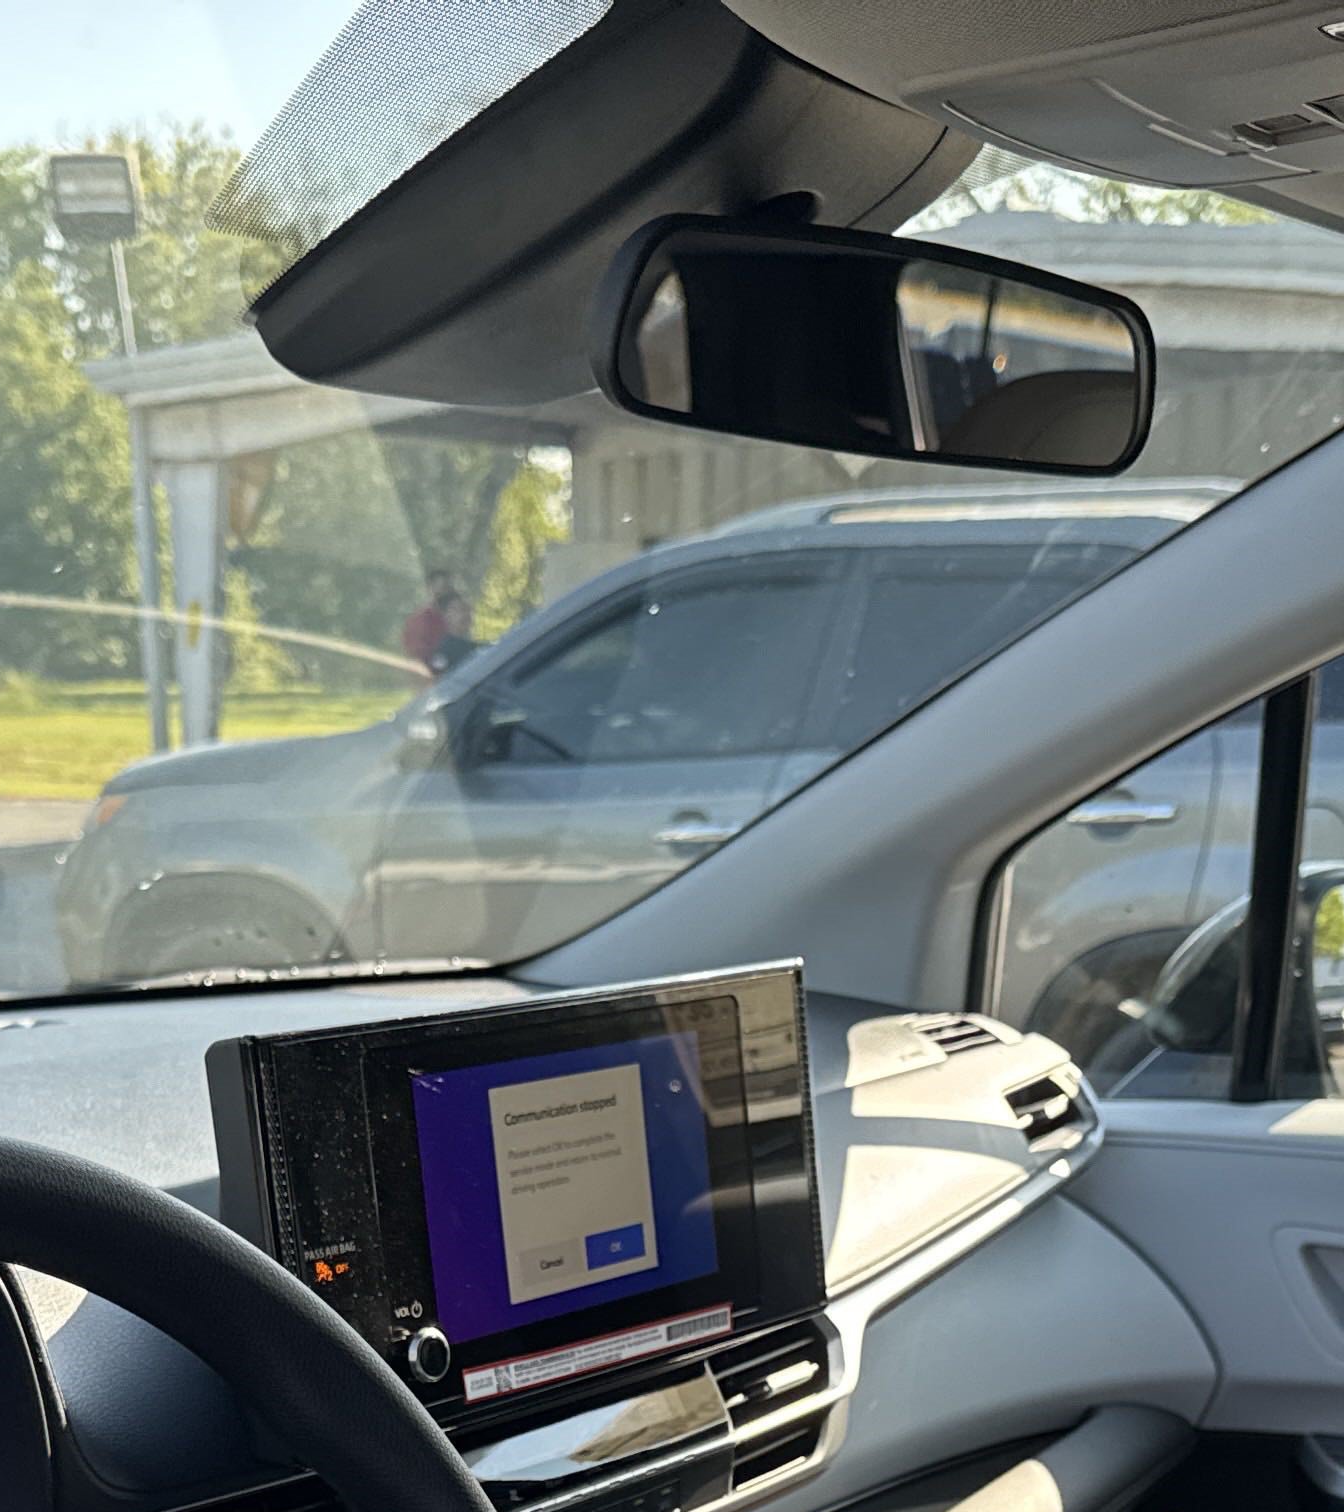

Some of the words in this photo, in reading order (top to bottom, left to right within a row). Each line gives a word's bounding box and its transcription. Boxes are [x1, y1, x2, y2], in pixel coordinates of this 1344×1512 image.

[504, 1103, 578, 1126] Communication
[579, 1094, 616, 1112] stopped
[304, 1248, 324, 1261] PASS
[325, 1244, 339, 1258] AIR
[340, 1241, 356, 1254] BAG
[335, 1262, 349, 1274] OFF
[540, 1256, 564, 1270] Cancel
[394, 1306, 410, 1319] VOL
